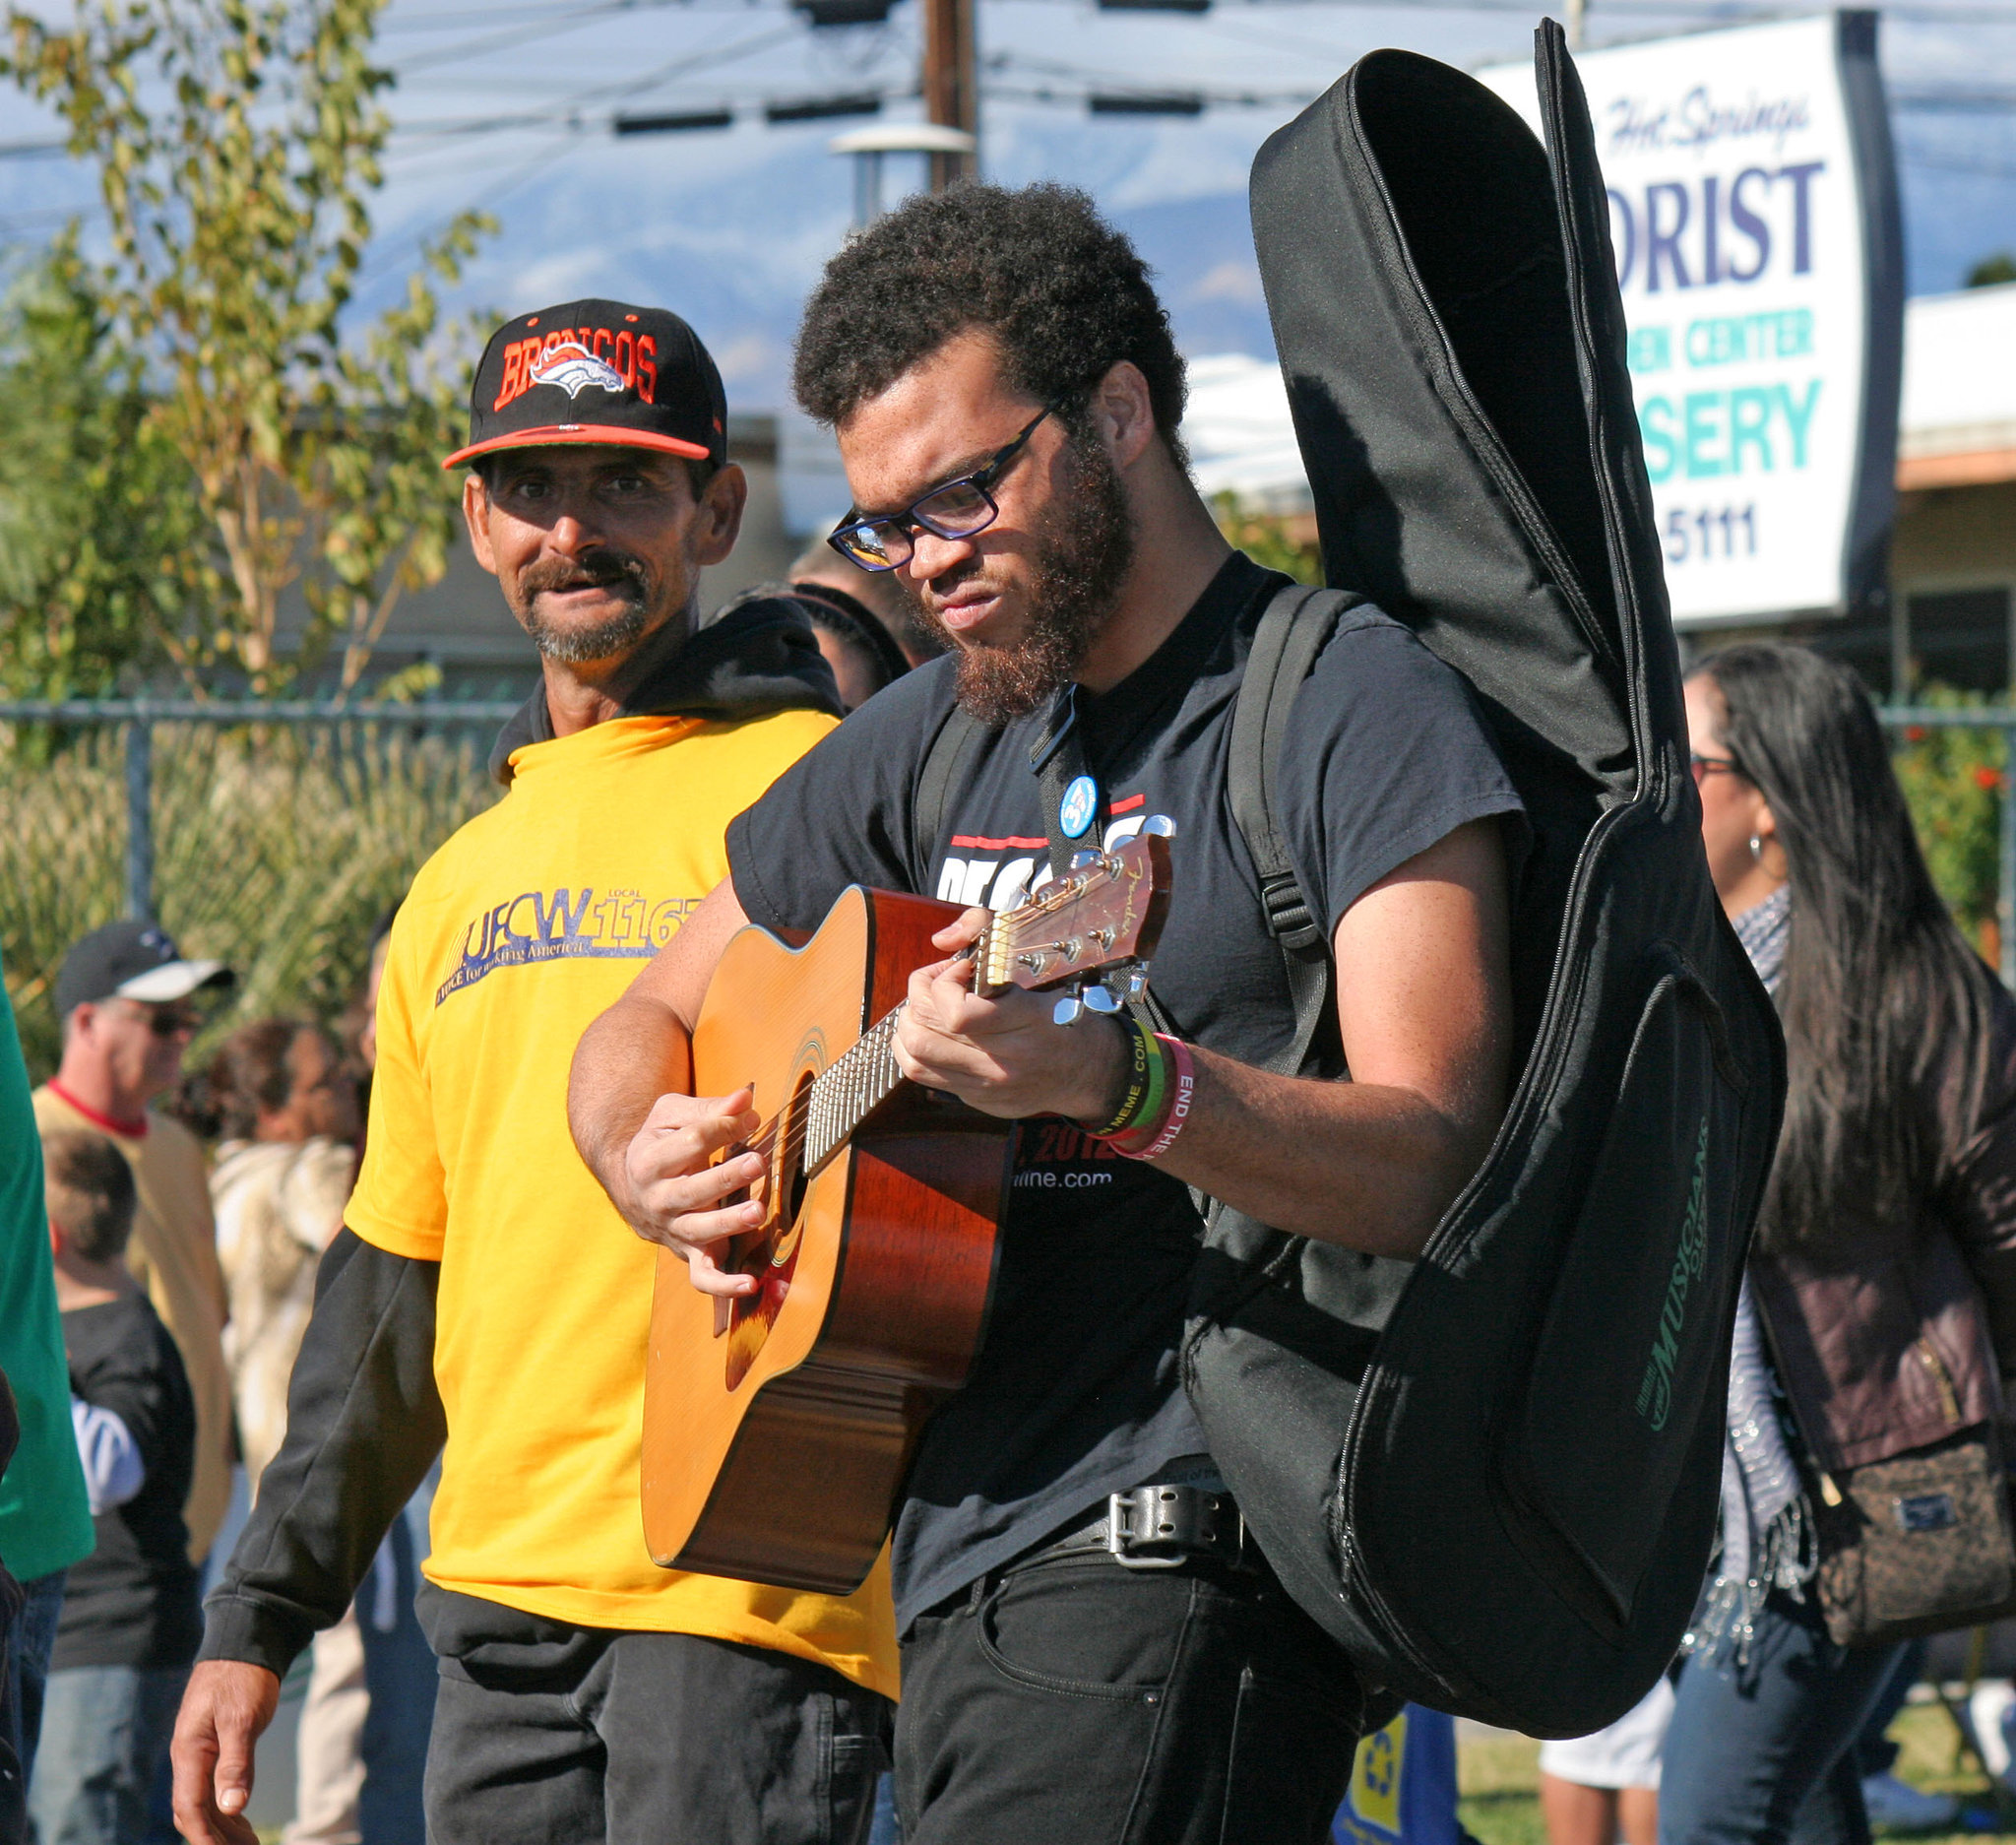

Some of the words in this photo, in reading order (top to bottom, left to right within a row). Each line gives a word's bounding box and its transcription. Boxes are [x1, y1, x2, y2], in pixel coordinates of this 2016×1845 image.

[1686, 307, 1814, 368] CENTER
[494, 328, 658, 412] BRCOS
[608, 888, 642, 898] LOCAL
[463, 888, 594, 963] UFCW
[466, 966, 483, 982] for
[528, 941, 584, 959] America
[1110, 1084, 1142, 1126] MEME
[1175, 1075, 1194, 1117] END
[1151, 1123, 1182, 1154] THE
